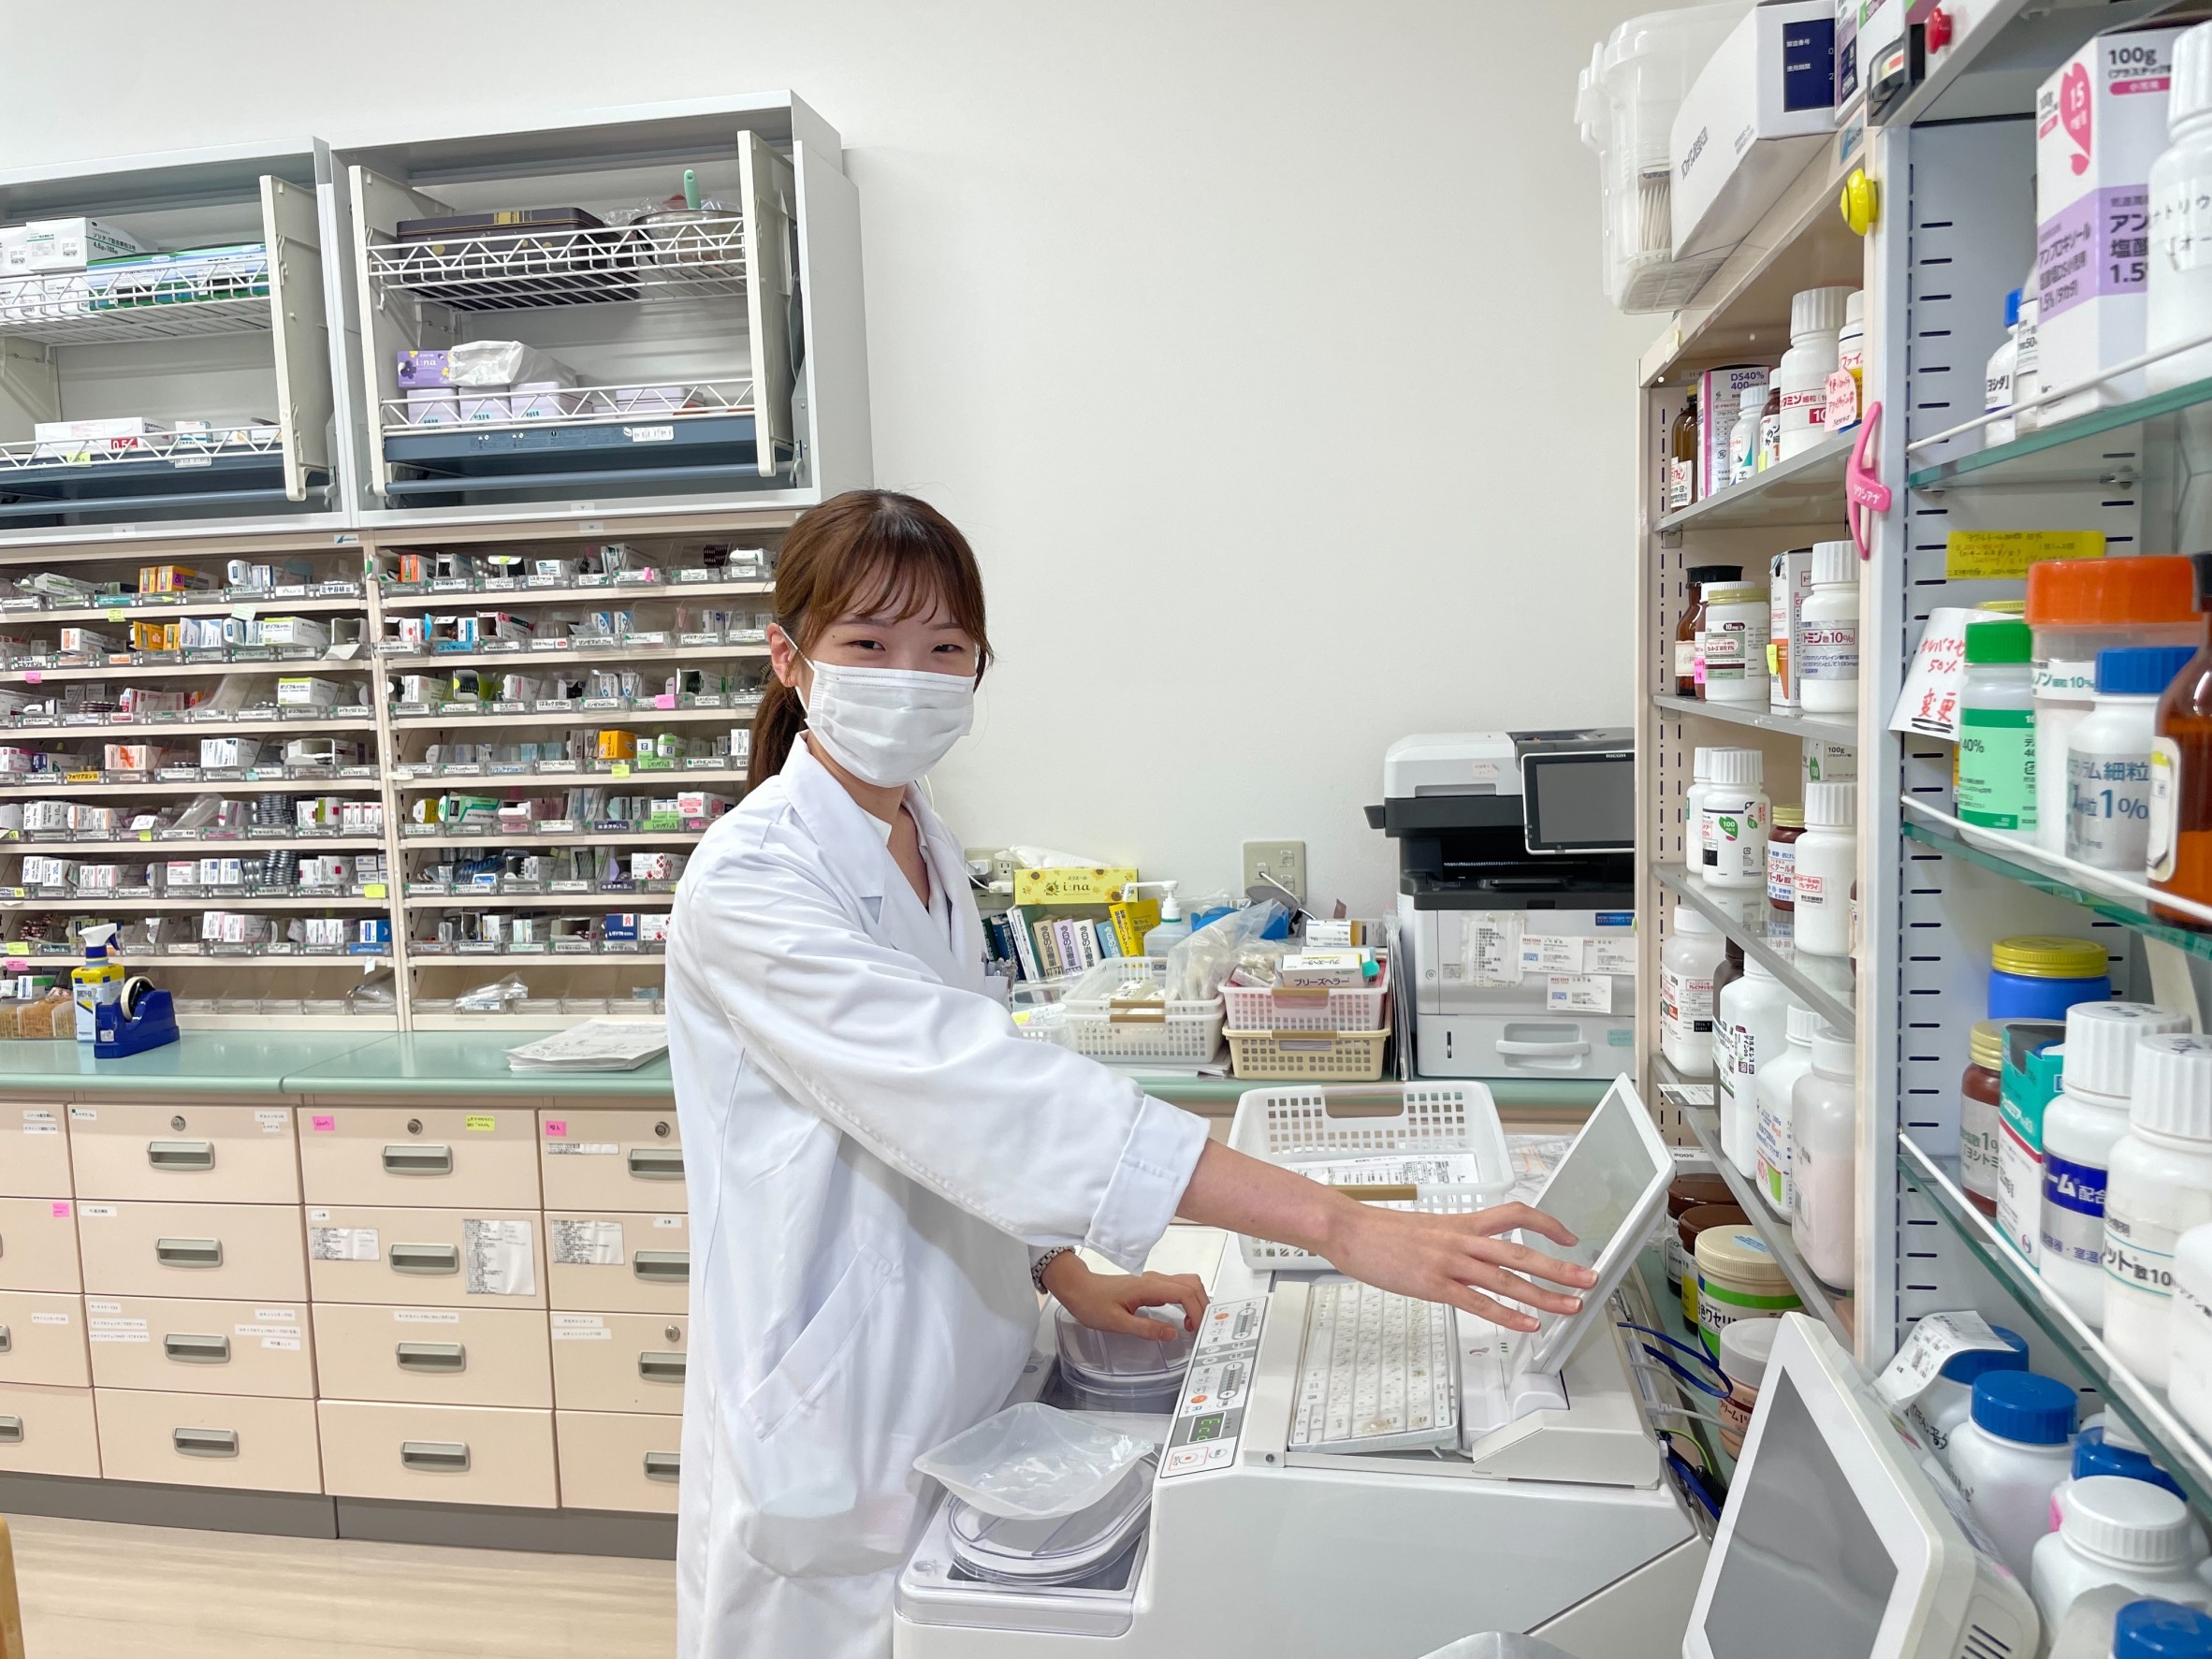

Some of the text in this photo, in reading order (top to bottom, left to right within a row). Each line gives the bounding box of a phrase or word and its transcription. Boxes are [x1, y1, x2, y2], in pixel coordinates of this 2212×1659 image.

[2108, 47, 2158, 65] 100g
[2069, 80, 2086, 112] 15
[2109, 262, 2149, 284] 1.5
[1730, 371, 1765, 383] DS40%
[1928, 658, 1958, 675] 50%
[2031, 671, 2095, 689] ノン細粒10%
[1917, 687, 1957, 723] 変更
[1960, 737, 1986, 754] 40%
[1040, 924, 1057, 968] 今日の治療薬
[1059, 924, 1077, 968] 今日の治療薬
[1079, 924, 1096, 969] 今日の治療薬
[1294, 976, 1350, 987] ブリーズヘラー
[2042, 1167, 2106, 1205] ーム配合
[2104, 1239, 2175, 1288] ット散10
[1697, 1299, 1738, 1328] 色ワセリ
